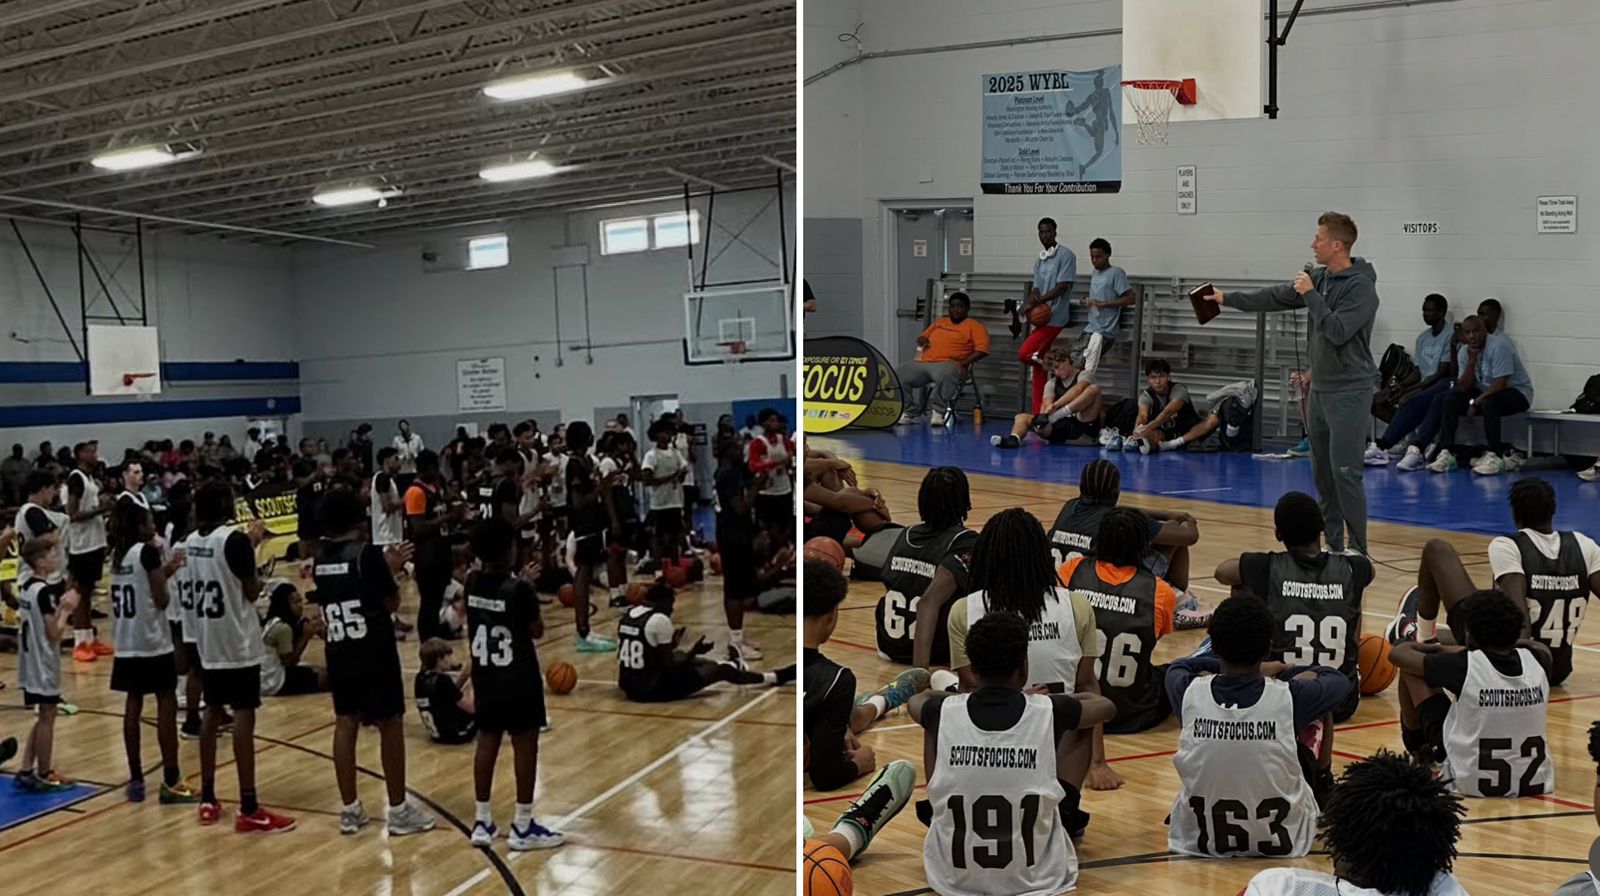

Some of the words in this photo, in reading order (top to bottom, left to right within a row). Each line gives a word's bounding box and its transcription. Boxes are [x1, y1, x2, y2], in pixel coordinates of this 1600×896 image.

[989, 76, 1024, 93] 2025
[1029, 73, 1070, 90] WYBL
[1029, 147, 1040, 155] Level
[1005, 183, 1022, 193] Thank
[1023, 184, 1033, 193] You
[1034, 183, 1044, 192] For
[1045, 183, 1058, 192] Your
[1059, 182, 1097, 192] Contribution
[1182, 180, 1190, 188] AND
[1403, 223, 1437, 233] VISITORS
[111, 584, 136, 619] 50
[1074, 589, 1136, 614] UTSFOCUS.COM
[1282, 581, 1343, 600] SCOUTSFOCUS.COM
[325, 599, 368, 642] 65
[1029, 622, 1060, 641] CUS.COM
[471, 624, 513, 666] 43
[620, 638, 644, 669] 48
[1283, 614, 1347, 670] 39
[1479, 684, 1545, 707] SCOUTSFOCUS.COM
[1194, 718, 1276, 740] SCOUTSFOCUS.COM
[949, 745, 1037, 770] SCOUTSFOCUS.COM
[1478, 735, 1546, 797] 52
[947, 794, 1040, 869] 191
[1189, 796, 1293, 857] 163
